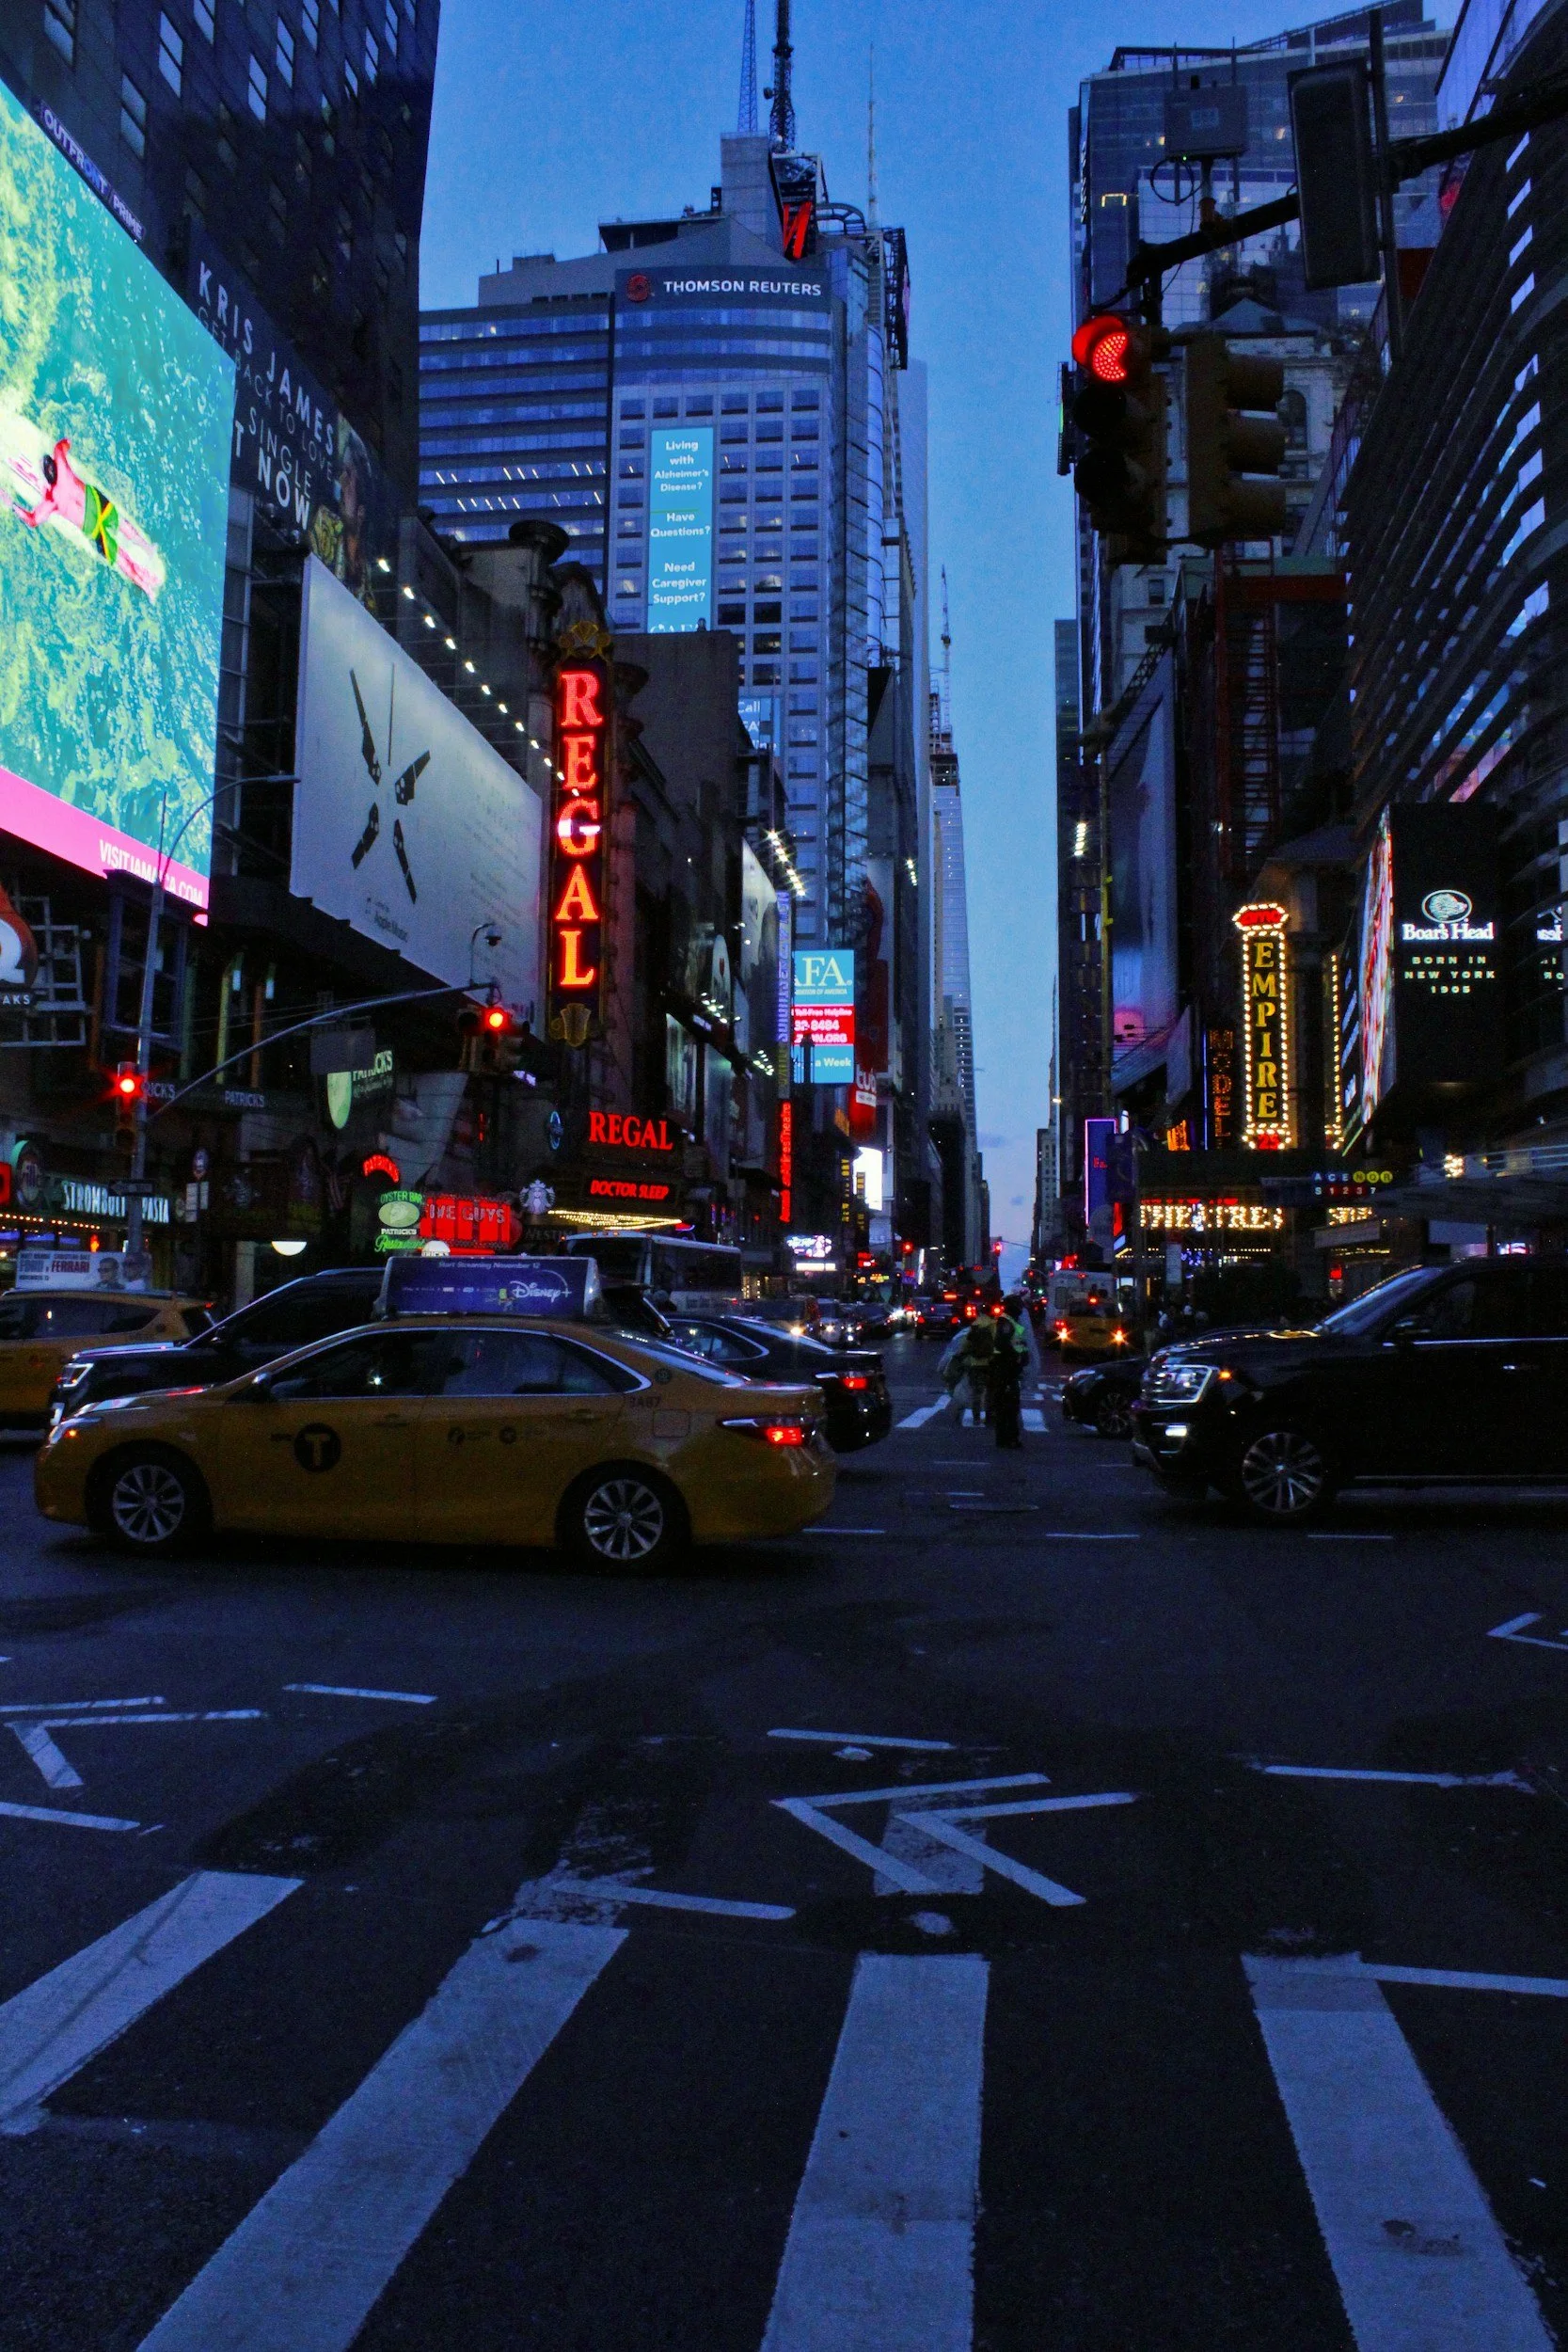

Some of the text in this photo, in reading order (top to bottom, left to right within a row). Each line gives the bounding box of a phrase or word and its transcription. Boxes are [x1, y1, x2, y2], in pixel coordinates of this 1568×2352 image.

[44, 109, 108, 195] OUTFRONT
[663, 279, 822, 296] THOMSON REUTERS
[199, 260, 333, 455] KRIS JAMES
[249, 405, 312, 499] SINGLE
[666, 440, 699, 452] Living
[670, 454, 694, 465] with
[258, 447, 310, 531] NOW
[660, 482, 703, 492] Disease?
[667, 513, 695, 522] Have
[651, 526, 711, 538] Questions?
[664, 562, 695, 572] Need
[652, 578, 706, 590] Caregiver
[653, 592, 705, 605] Support?
[556, 674, 603, 986] REGAL
[1402, 921, 1494, 940] Boar's Head
[1412, 956, 1486, 964] BORN IN
[1404, 971, 1495, 979] NEW YORK
[1431, 985, 1470, 993] 1905
[1251, 942, 1278, 1119] EMPIRE
[823, 1057, 851, 1067] Week
[589, 1110, 673, 1151] REGAL
[1314, 1172, 1323, 1182] A
[1342, 1172, 1350, 1182] E
[590, 1179, 671, 1200] DOCTOR SLEEP
[1314, 1186, 1323, 1195] S
[1330, 1186, 1335, 1195] 1
[1343, 1186, 1350, 1195] 2
[1356, 1186, 1363, 1195] 3
[380, 1190, 408, 1203] OYSTER
[426, 1203, 505, 1224] IVE GUYS
[52, 1260, 90, 1273] FERRARI
[493, 1261, 531, 1269] November
